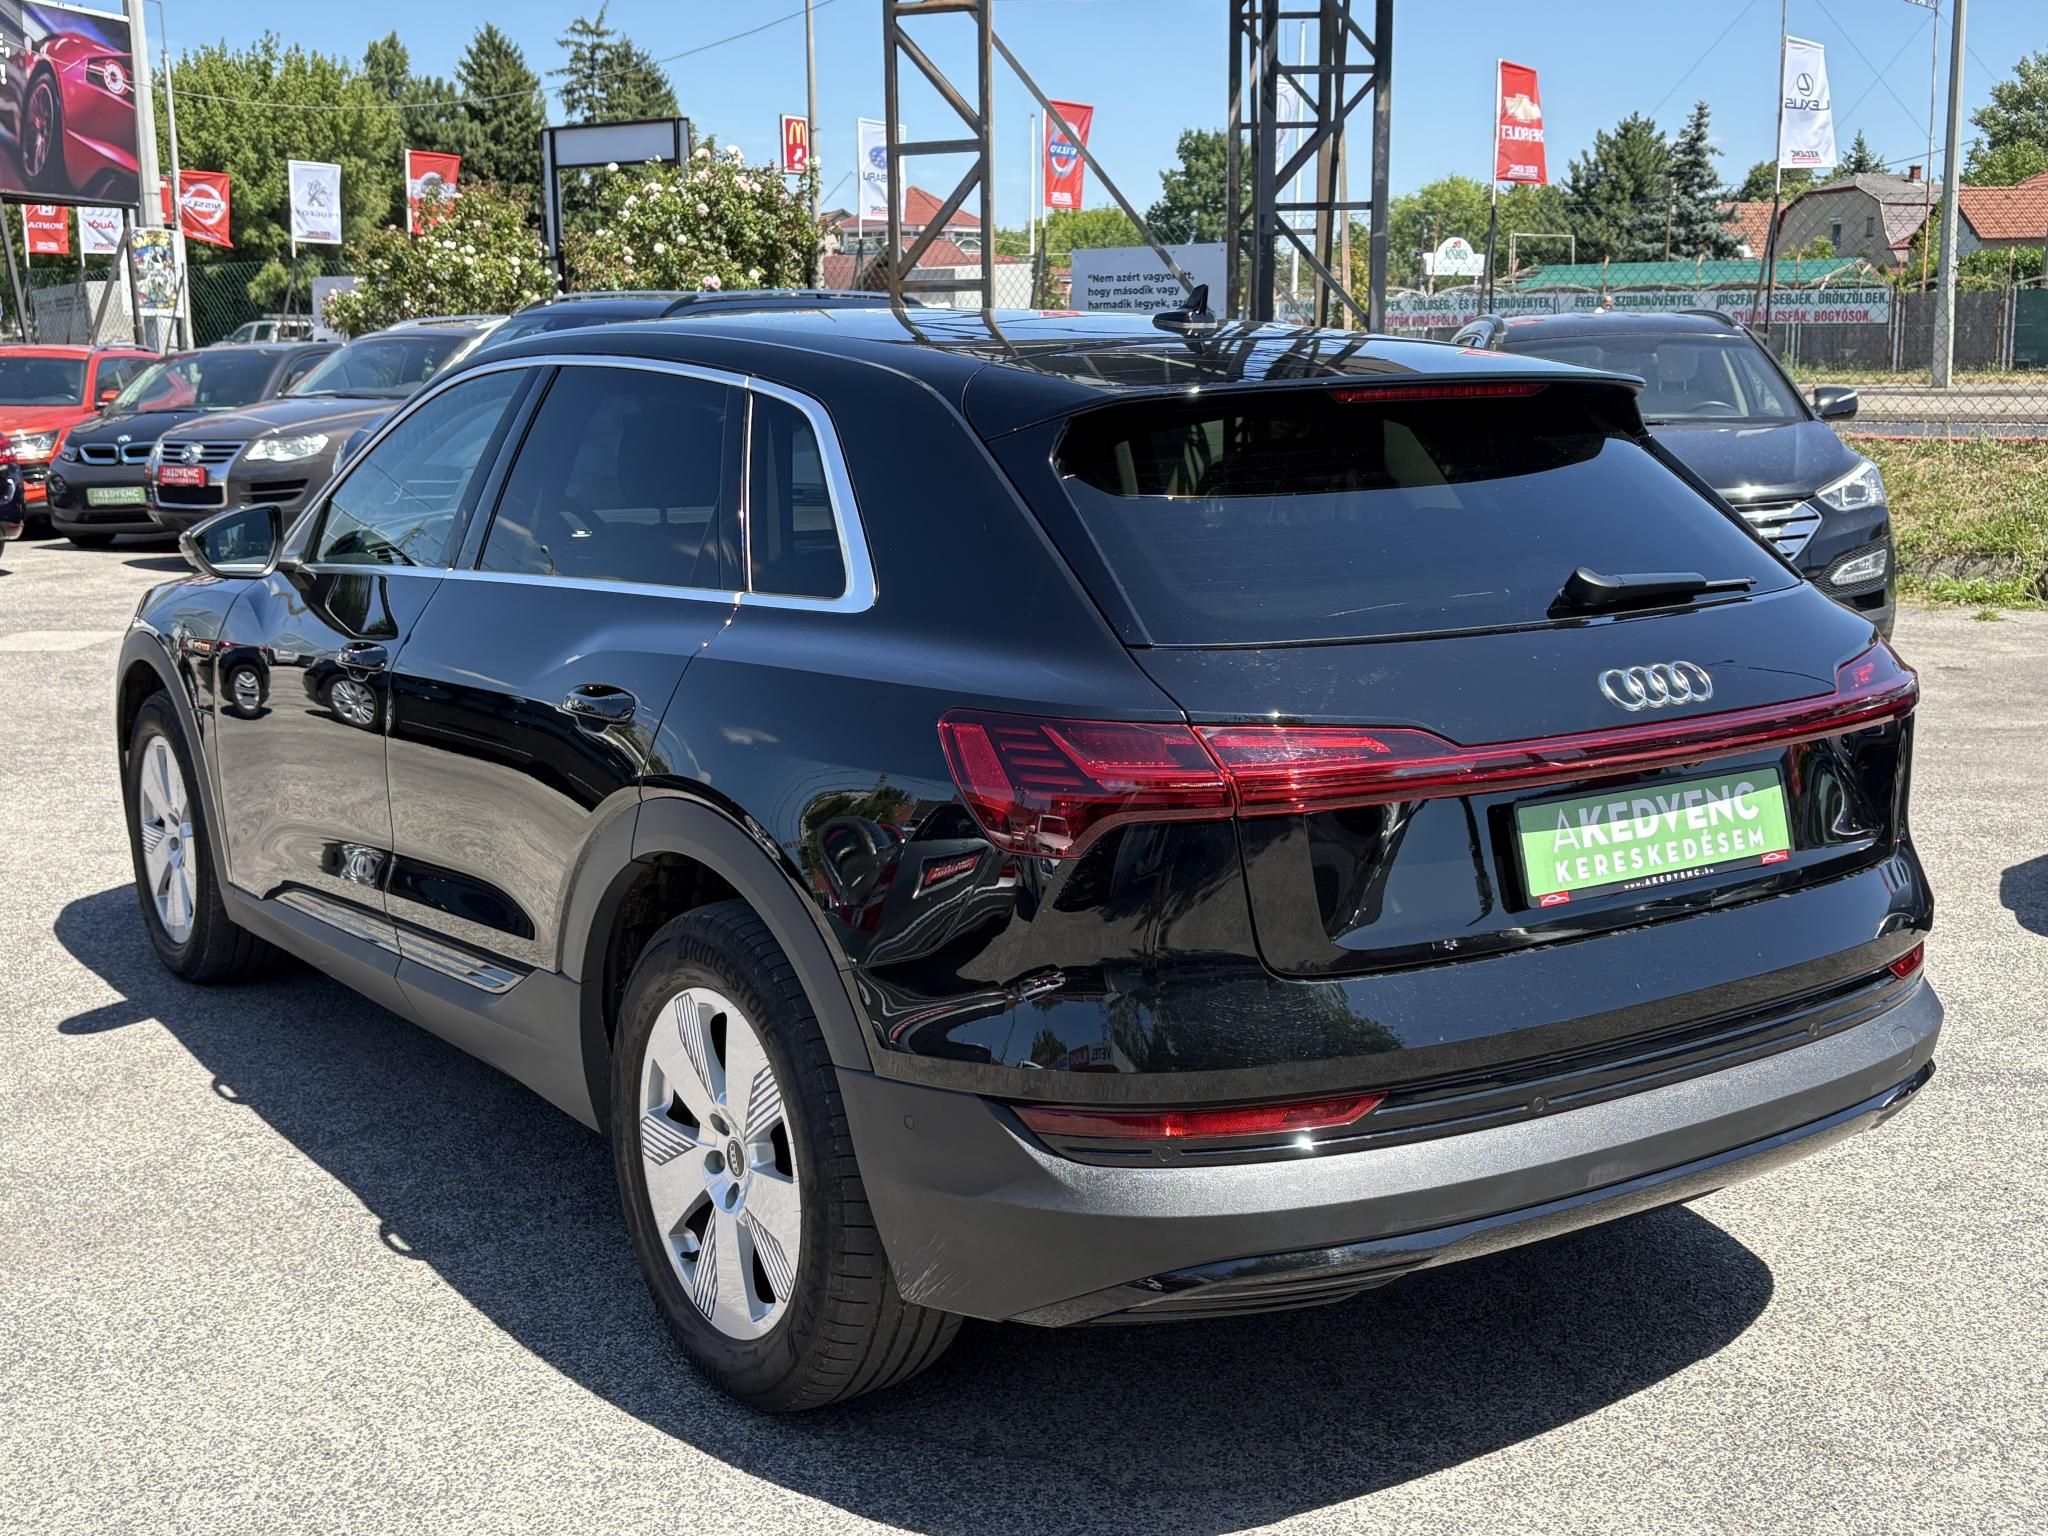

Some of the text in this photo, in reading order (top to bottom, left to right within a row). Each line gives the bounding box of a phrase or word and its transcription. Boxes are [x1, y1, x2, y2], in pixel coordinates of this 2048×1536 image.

[1116, 271, 1140, 282] azért
[1088, 285, 1180, 298] hogy második vagy
[1088, 300, 1130, 311] harmadik
[1134, 299, 1170, 310] legyek,
[1553, 781, 1760, 854] AKEDVENC
[1555, 825, 1765, 884] KERESKEDÉSEM
